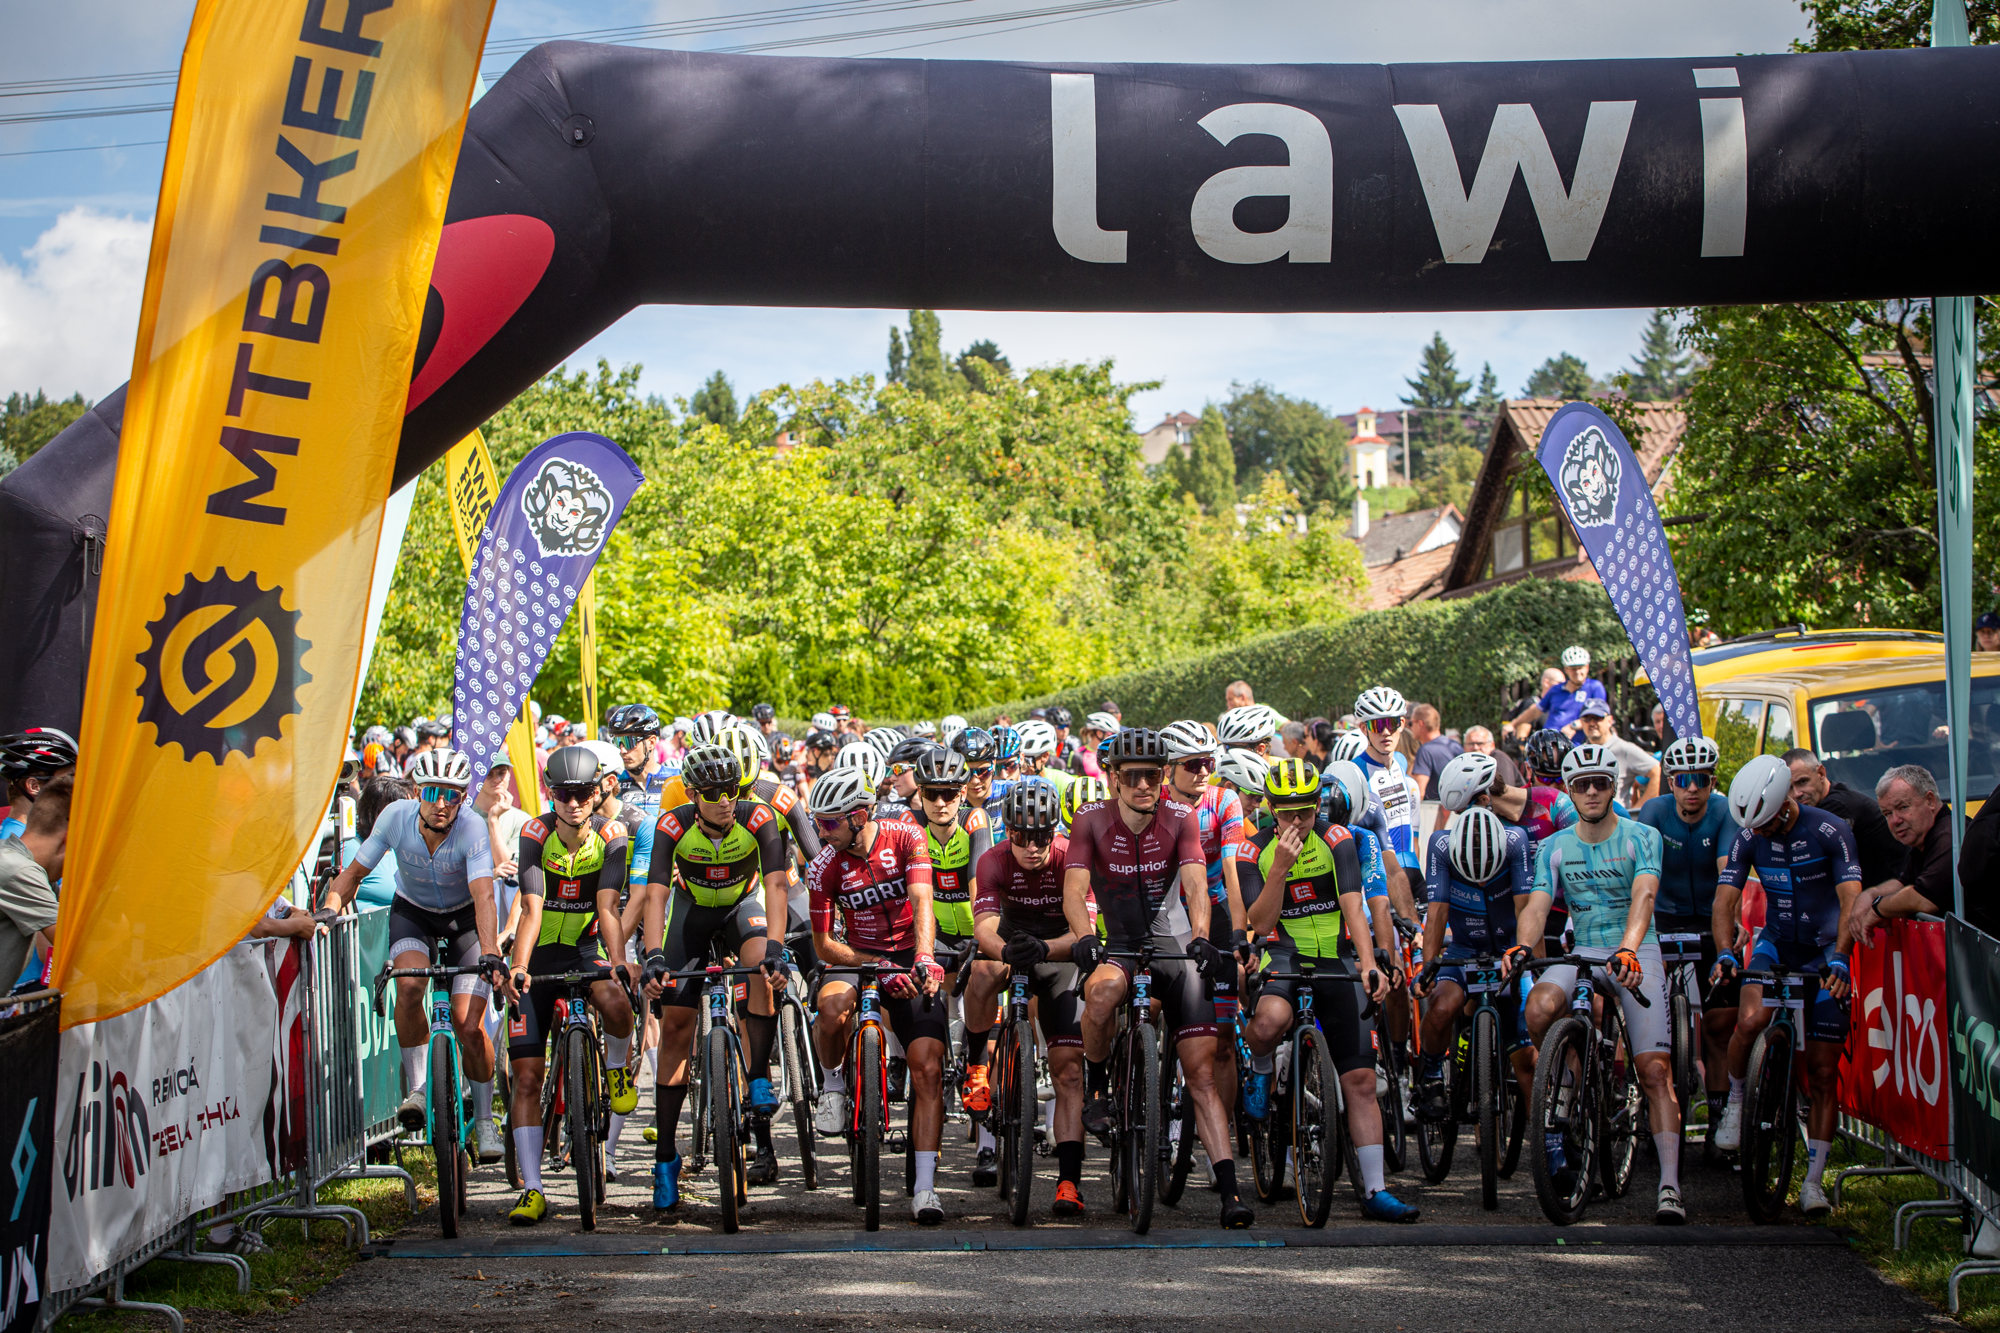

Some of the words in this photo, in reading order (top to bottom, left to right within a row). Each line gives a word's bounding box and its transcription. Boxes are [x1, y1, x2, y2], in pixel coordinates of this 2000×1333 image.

[1051, 67, 1748, 264] lawi
[401, 851, 462, 874] VIVERE
[710, 874, 744, 888] GROUP
[1565, 869, 1624, 882] CANYON
[560, 901, 593, 910] GROUP
[1281, 908, 1301, 916] CEZ
[1302, 900, 1336, 913] GROUP
[1477, 971, 1498, 984] 22
[1014, 983, 1025, 996] 5
[1136, 983, 1147, 997] 3
[1577, 987, 1588, 1000] 2
[711, 994, 726, 1008] 21
[1298, 996, 1313, 1009] 17
[433, 1008, 450, 1022] 13
